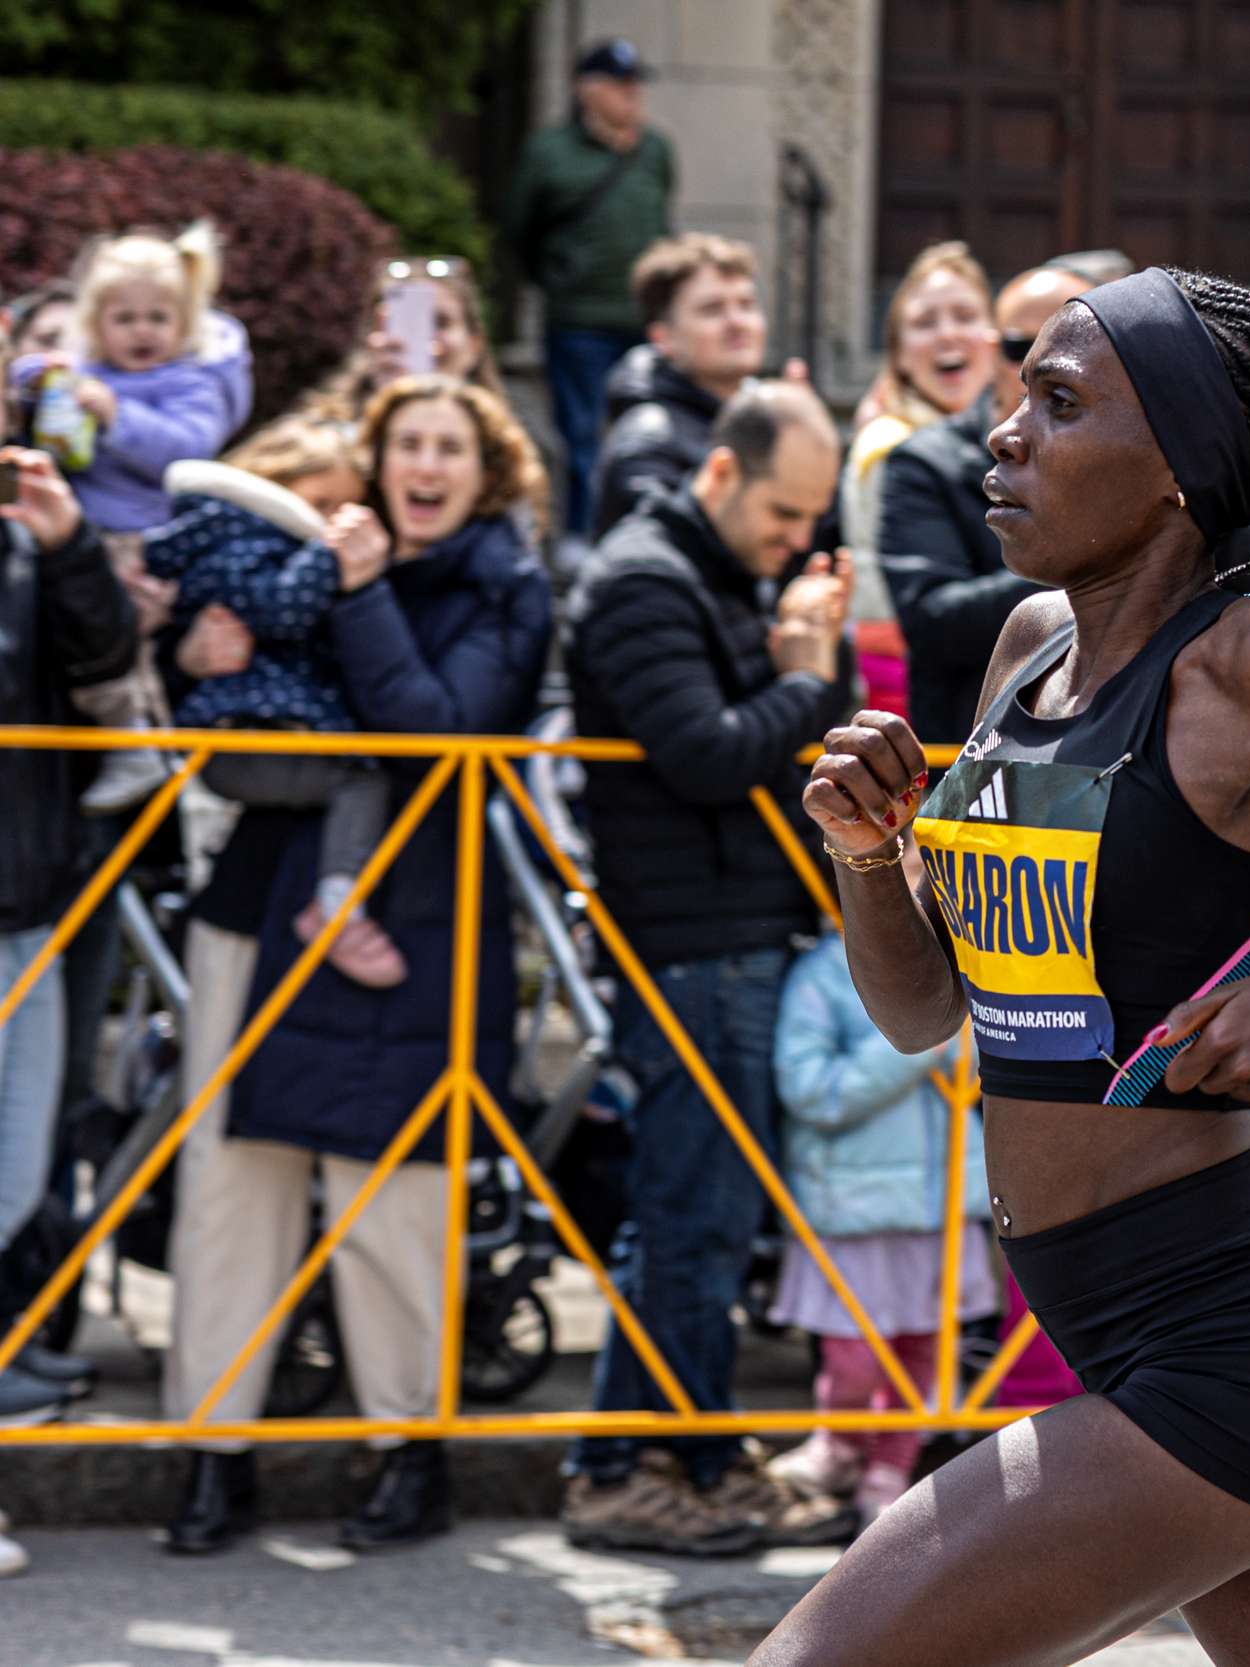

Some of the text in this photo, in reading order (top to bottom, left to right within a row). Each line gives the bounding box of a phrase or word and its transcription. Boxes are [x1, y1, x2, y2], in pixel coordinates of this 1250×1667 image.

[919, 845, 1088, 960] SHARON
[978, 1003, 1006, 1026] BOSTON
[1007, 1010, 1086, 1028] MARATHON
[986, 1027, 1017, 1042] AMERICA
